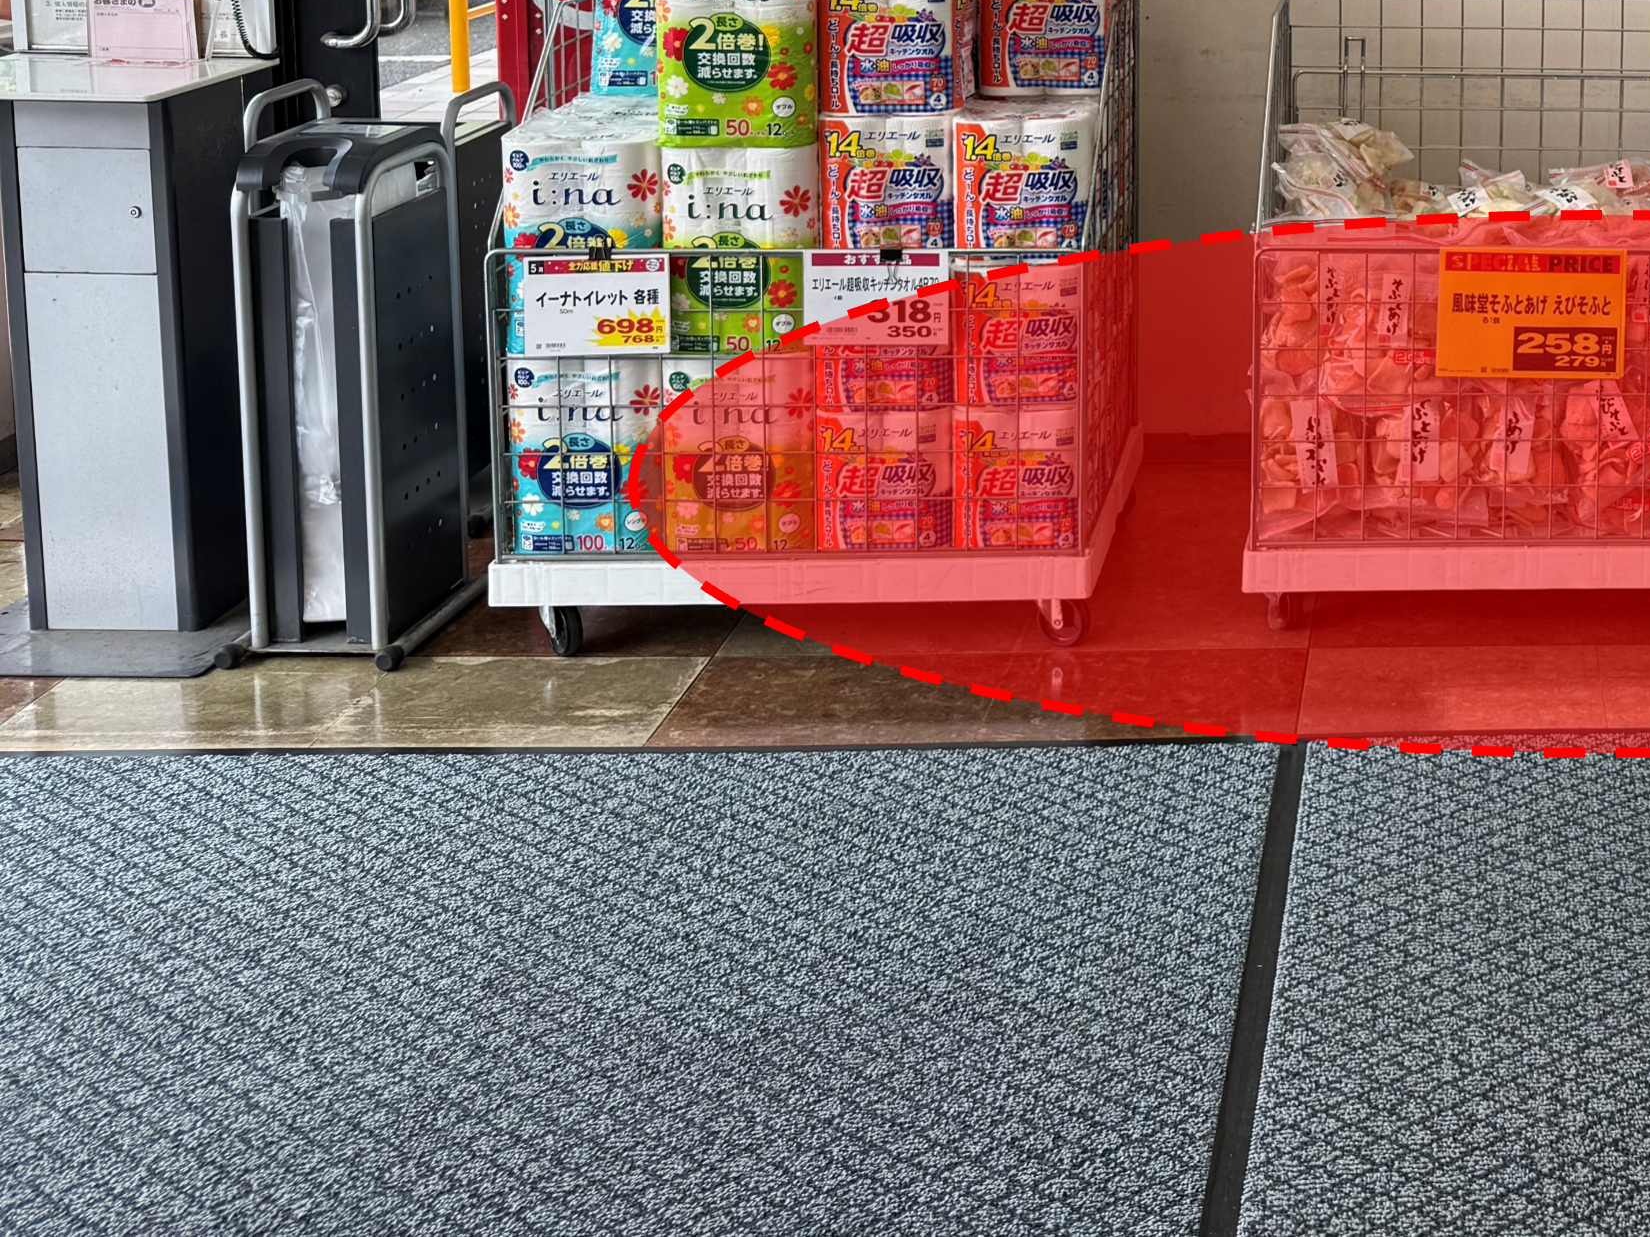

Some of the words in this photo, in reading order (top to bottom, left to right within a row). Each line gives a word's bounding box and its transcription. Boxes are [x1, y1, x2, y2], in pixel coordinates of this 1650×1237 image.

[716, 16, 738, 28] 長さ
[1047, 25, 1091, 35] キッチンタオル
[889, 46, 936, 56] キッチンタオル
[698, 52, 756, 66] 交換回数
[698, 66, 758, 79] 減らせます。
[548, 172, 599, 182] エリエール
[703, 186, 753, 196] エリエール
[565, 220, 587, 232] 長さ
[844, 254, 912, 265] おすす品
[1549, 256, 1613, 273] PRICE
[536, 289, 629, 307] イーナトイレット
[634, 288, 660, 306] 各種
[1452, 292, 1549, 315] 風味堂そふとあげ
[1553, 295, 1611, 316] えびそふと
[887, 325, 932, 338] 350
[1554, 355, 1600, 367] 279
[551, 471, 608, 484] 交換回数
